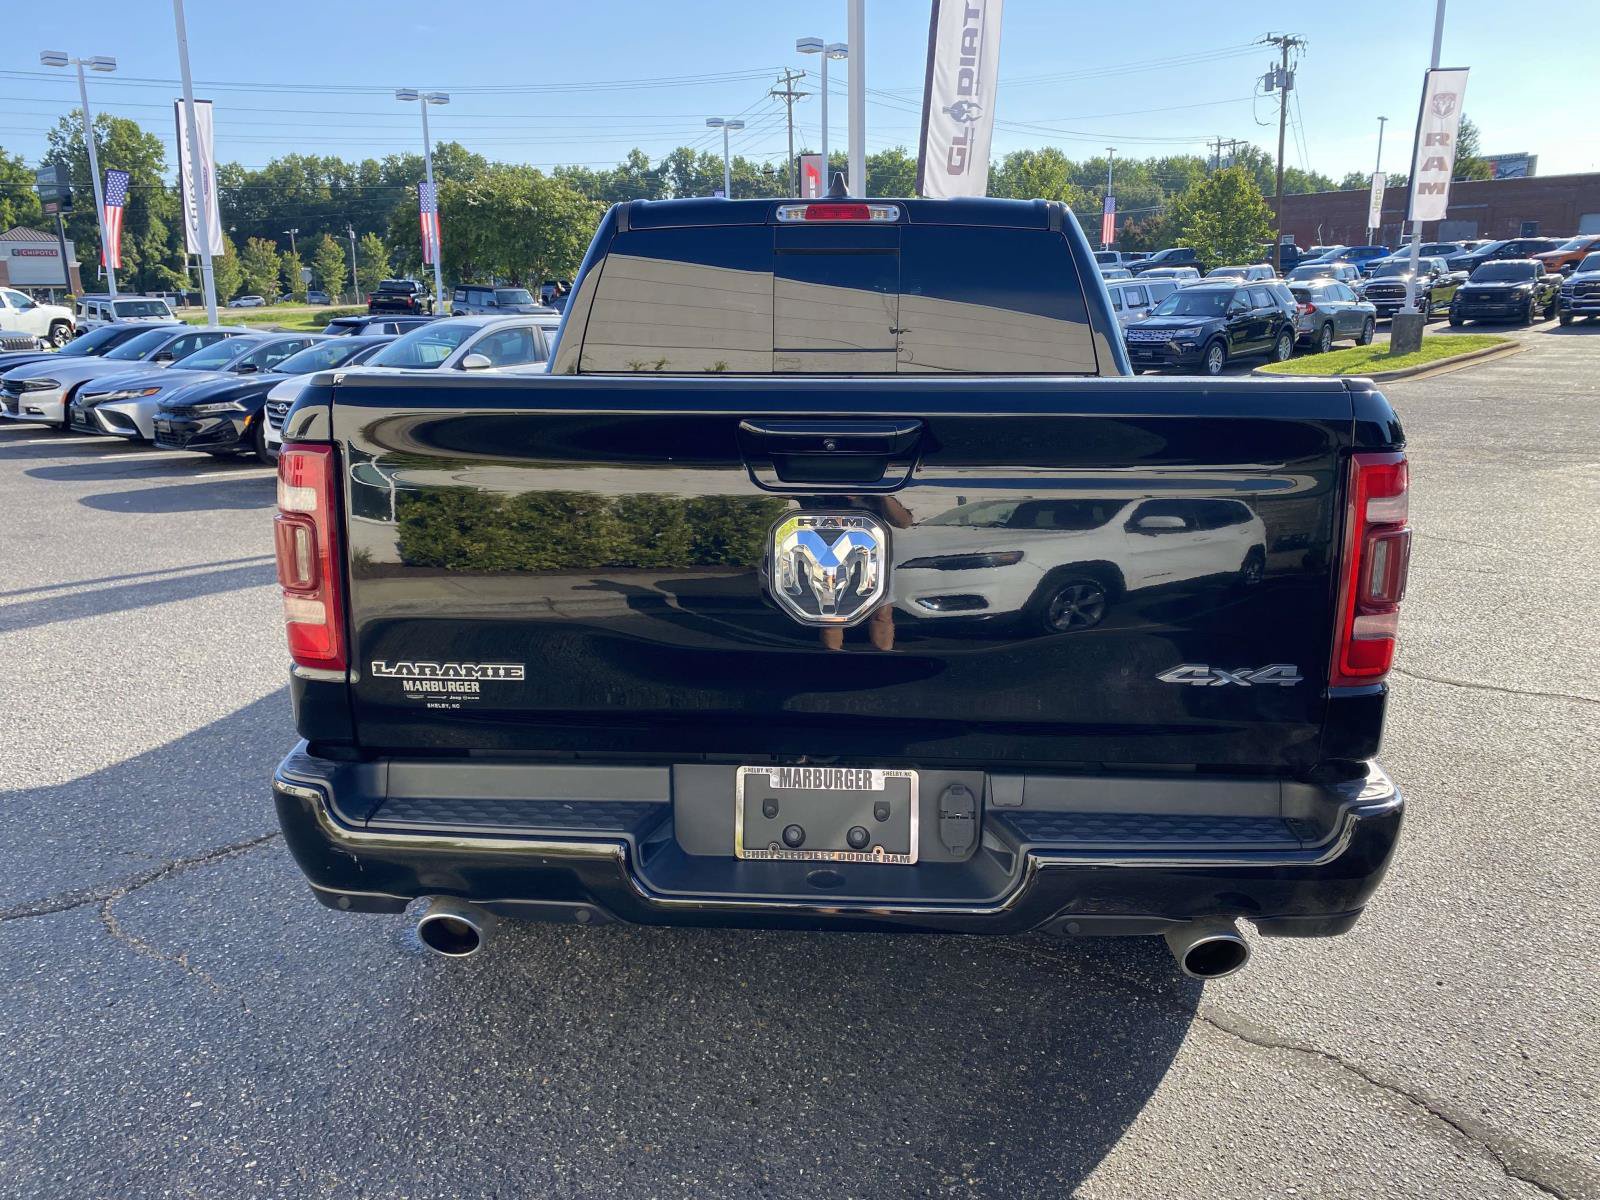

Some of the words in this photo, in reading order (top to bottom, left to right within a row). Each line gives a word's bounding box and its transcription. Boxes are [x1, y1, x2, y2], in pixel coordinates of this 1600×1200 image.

[1417, 132, 1451, 195] RAM
[1371, 188, 1382, 213] Jeep
[798, 518, 863, 527] RAM
[371, 661, 525, 681] LARAMIE
[403, 680, 480, 693] MARBURGER
[779, 768, 873, 790] MARBURGER
[743, 850, 807, 859] CHRYSLER
[807, 851, 836, 860] JEEP
[838, 852, 879, 862] DODGE
[882, 854, 911, 864] RAM
